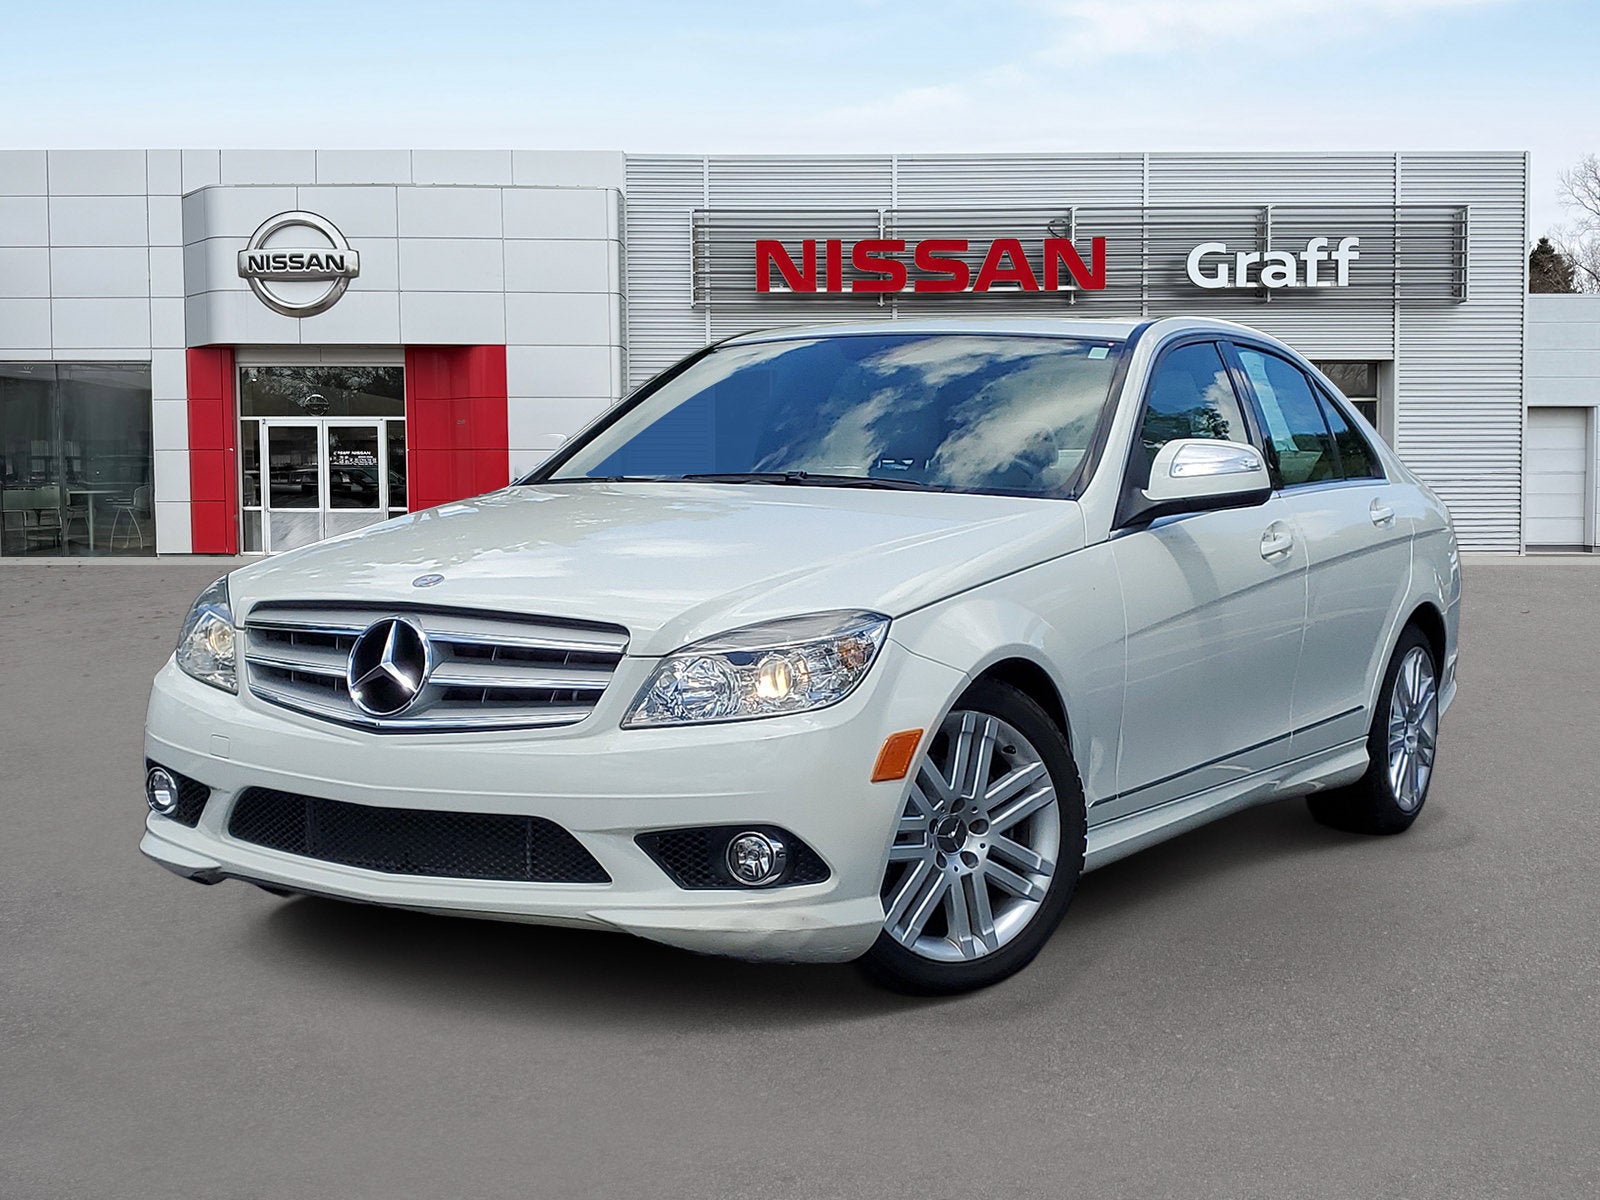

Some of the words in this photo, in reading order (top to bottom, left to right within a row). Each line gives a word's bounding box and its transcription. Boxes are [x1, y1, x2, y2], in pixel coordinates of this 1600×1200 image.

[247, 253, 345, 271] NISSAN
[756, 237, 1106, 292] NISSAN
[1186, 237, 1360, 288] Graff
